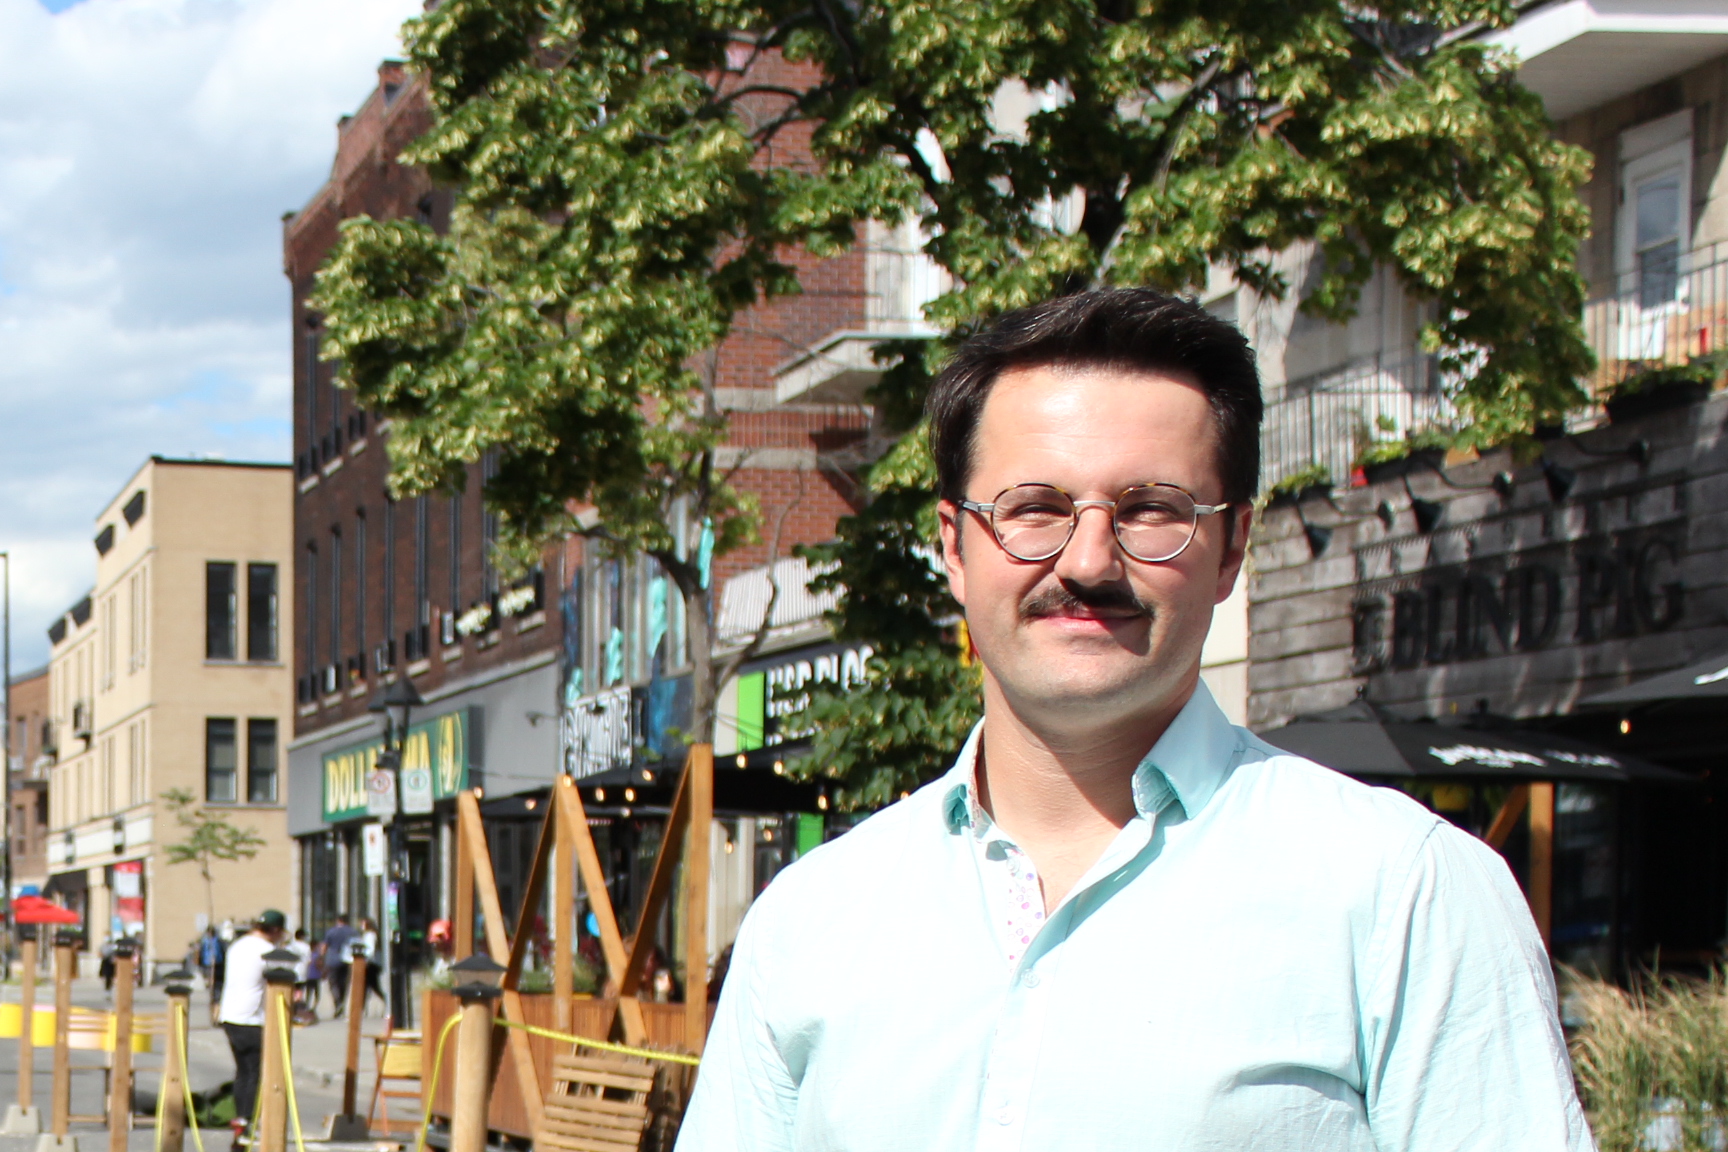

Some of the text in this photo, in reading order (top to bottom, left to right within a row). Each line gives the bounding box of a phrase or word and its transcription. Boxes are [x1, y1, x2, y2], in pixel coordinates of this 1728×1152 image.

[1392, 564, 1561, 668] BLIND
[1575, 537, 1685, 641] PIG
[326, 731, 430, 813] DOLLMA
